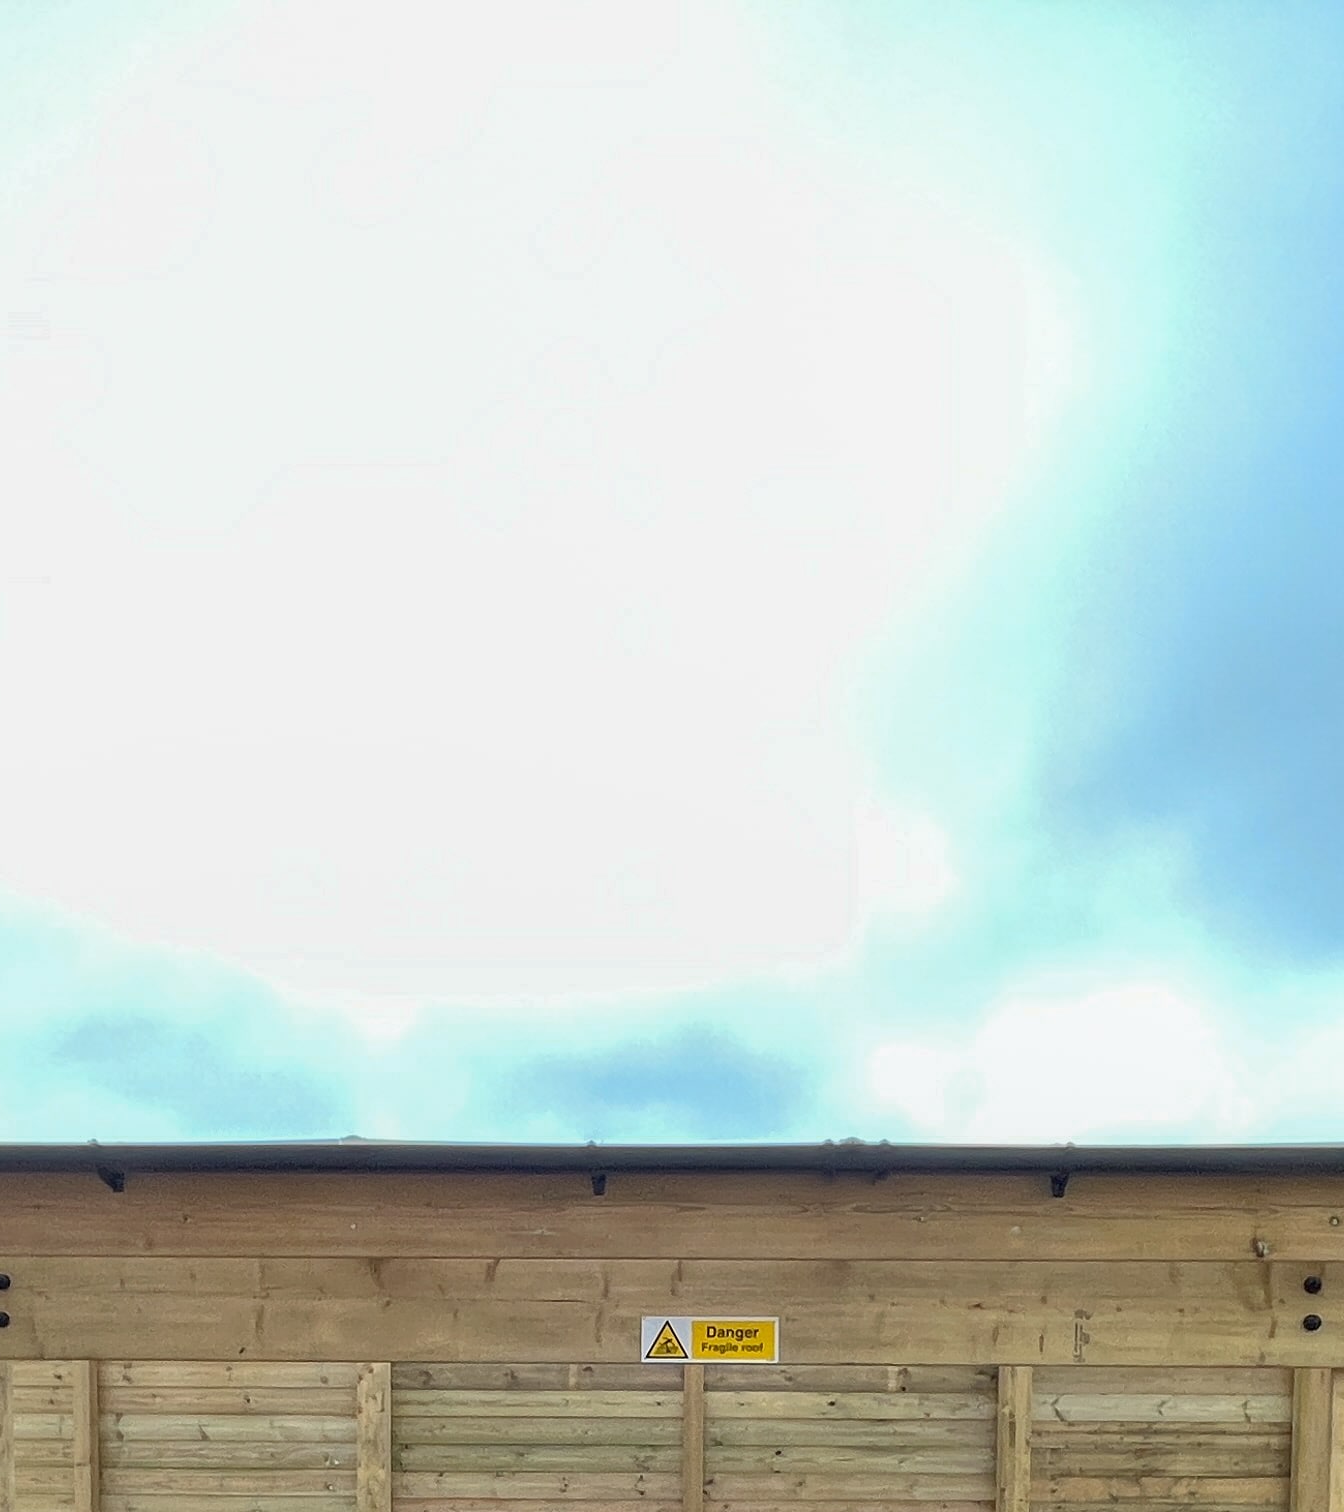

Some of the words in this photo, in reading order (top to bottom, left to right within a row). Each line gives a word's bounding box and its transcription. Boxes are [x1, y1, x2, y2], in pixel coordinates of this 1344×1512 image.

[706, 1326, 759, 1341] Danger
[702, 1342, 739, 1354] Fragile
[741, 1343, 763, 1352] roof
